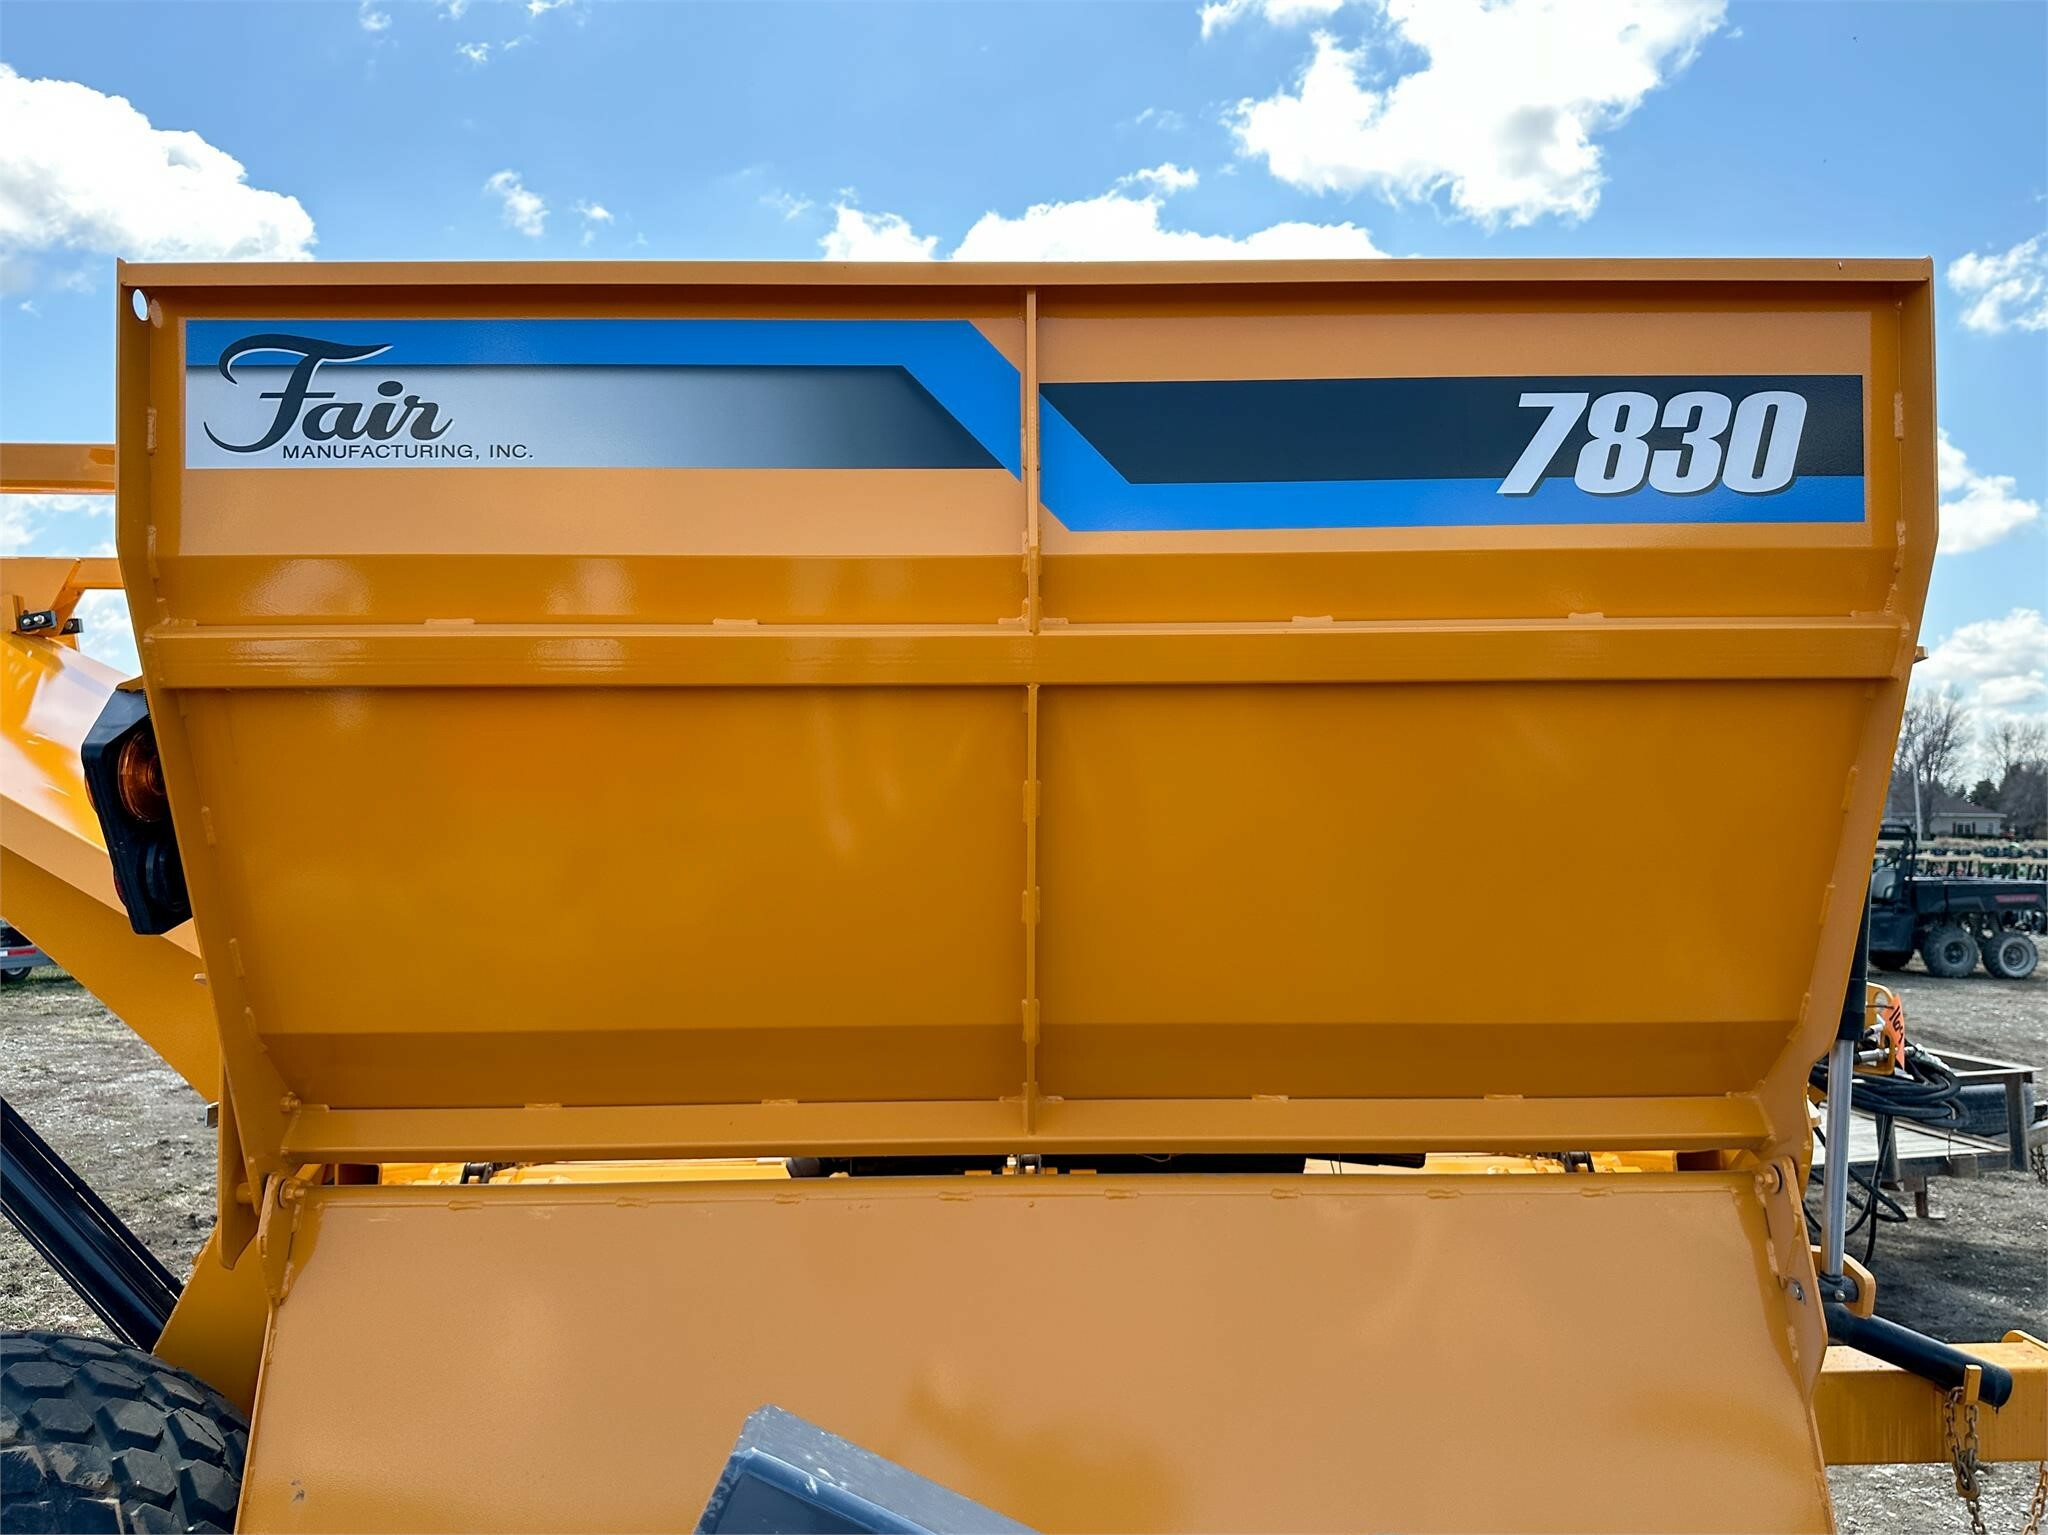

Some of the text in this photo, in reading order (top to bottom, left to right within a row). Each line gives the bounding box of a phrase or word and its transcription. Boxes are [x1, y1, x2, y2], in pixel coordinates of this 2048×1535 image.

[203, 333, 453, 453] Fair
[1496, 390, 1808, 497] 7830
[282, 444, 535, 461] MANUFACTURING, INC.
